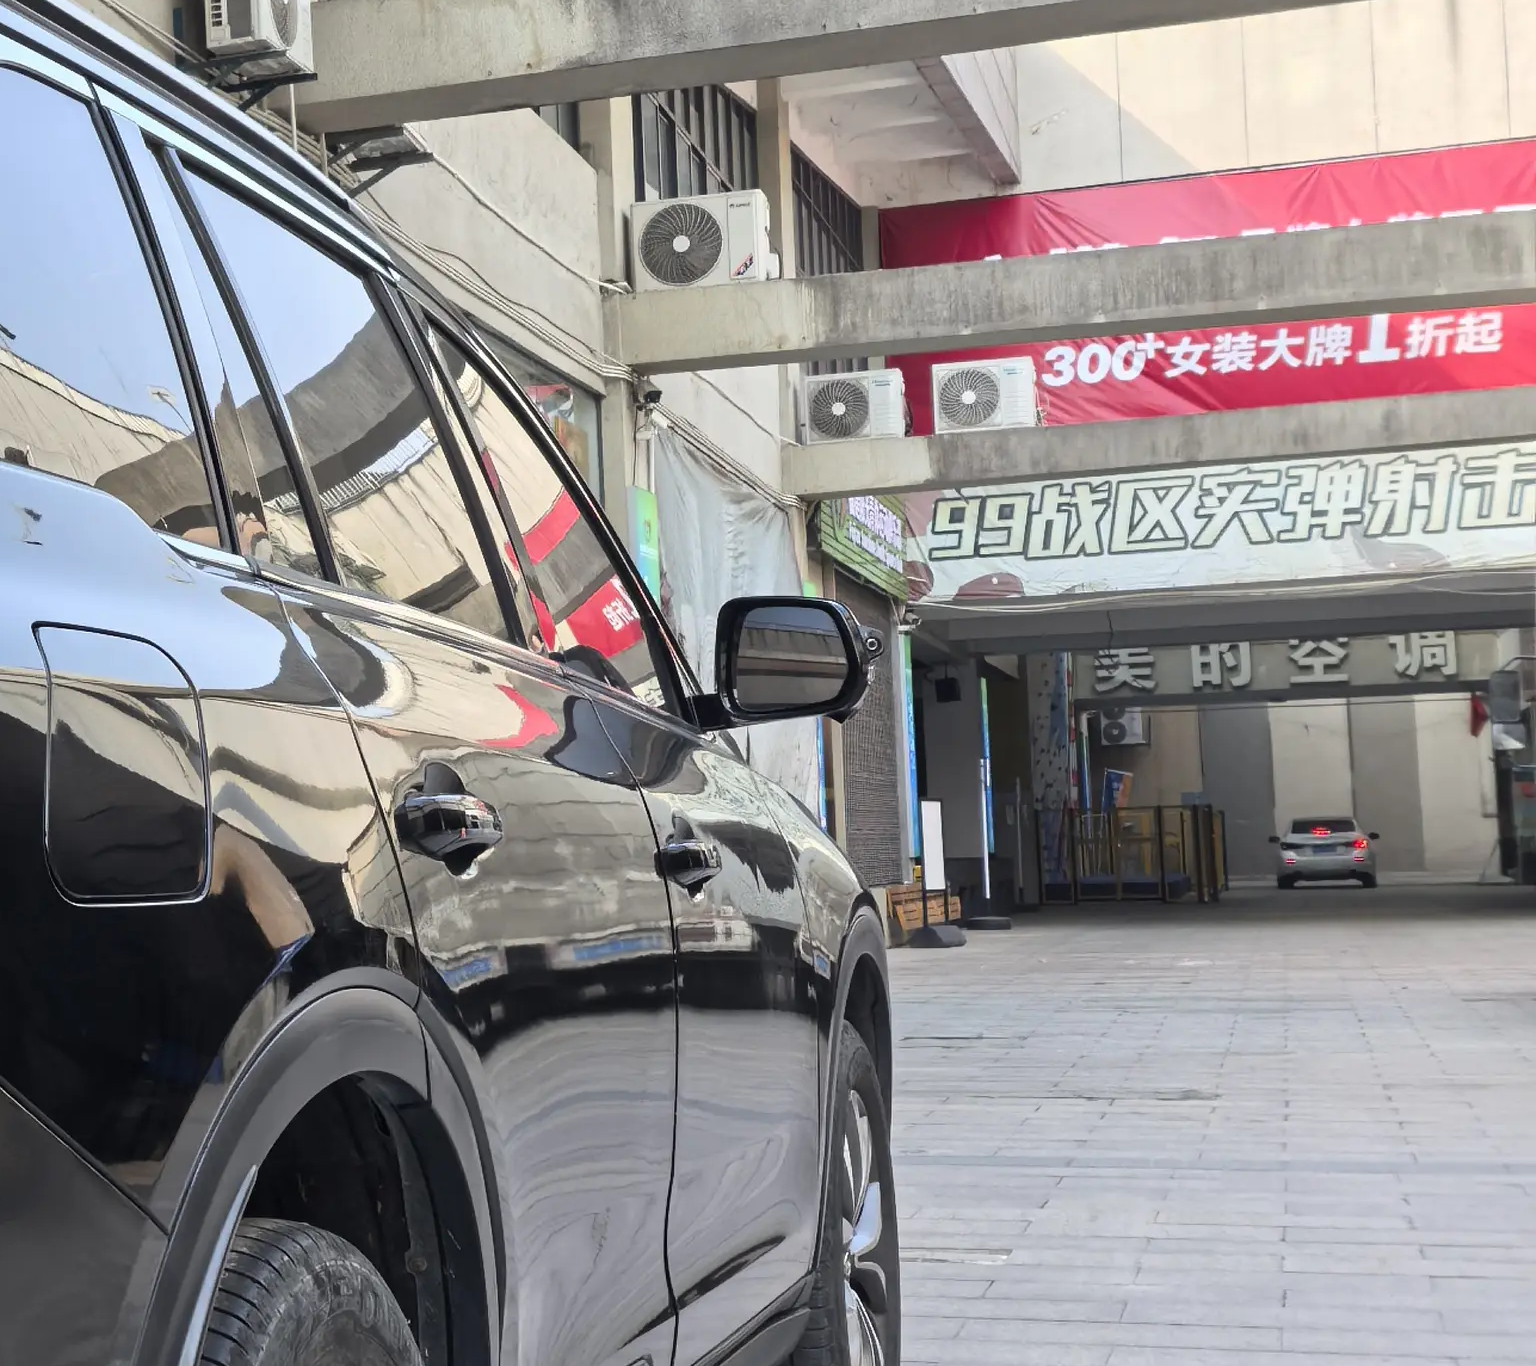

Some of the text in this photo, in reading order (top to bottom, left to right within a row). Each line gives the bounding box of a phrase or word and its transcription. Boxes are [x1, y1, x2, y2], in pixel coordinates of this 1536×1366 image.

[929, 448, 1536, 560] 99战区实弹射击
